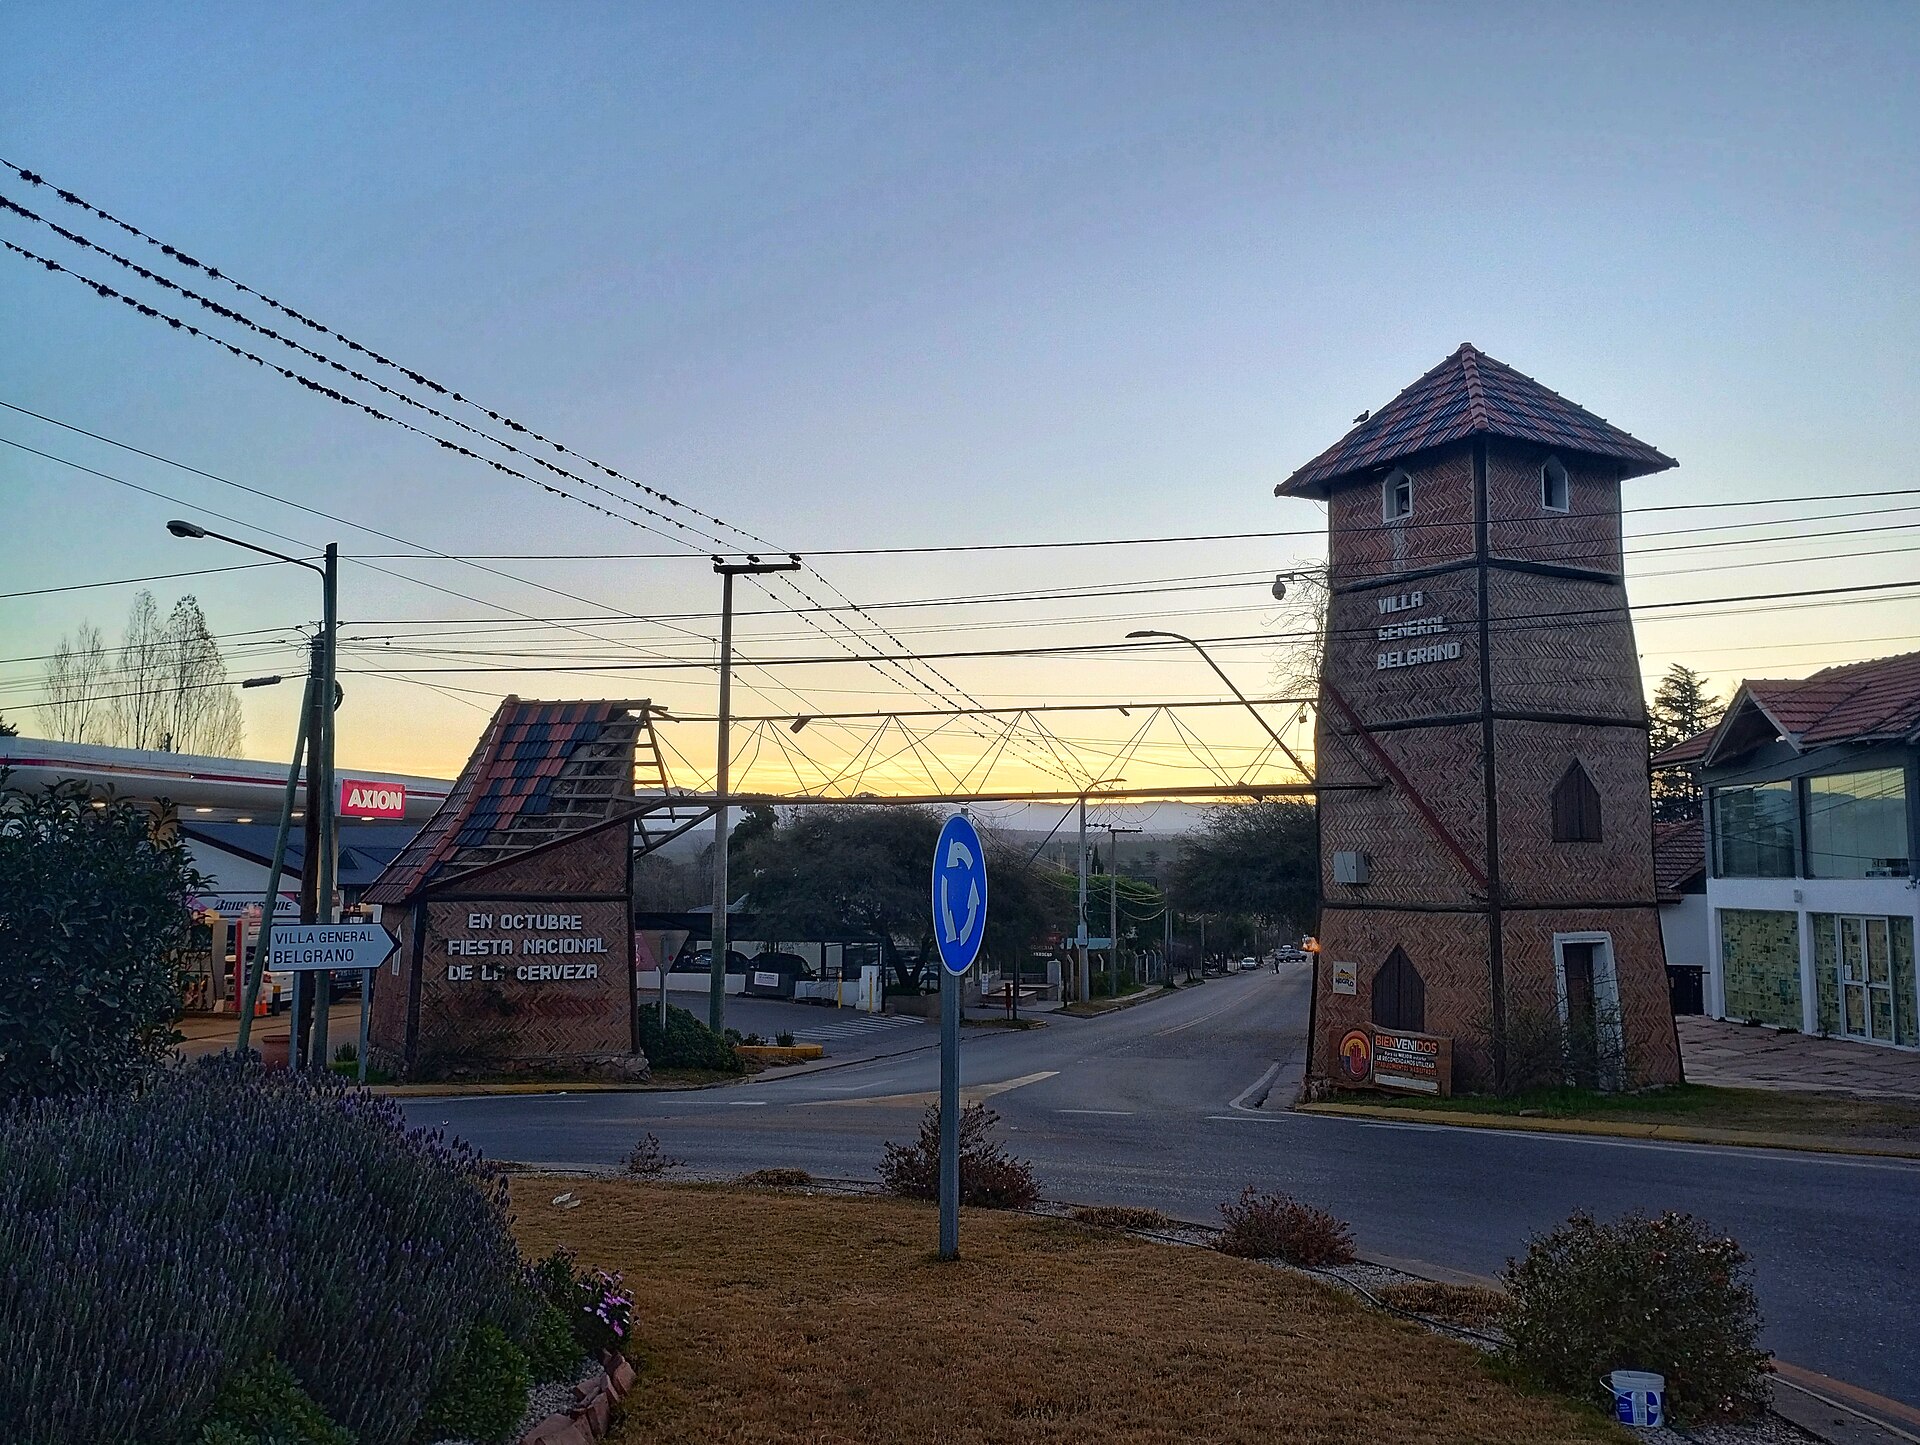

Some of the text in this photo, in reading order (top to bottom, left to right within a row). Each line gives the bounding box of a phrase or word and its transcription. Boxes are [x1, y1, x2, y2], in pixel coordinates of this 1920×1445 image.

[1378, 591, 1424, 615] VILLA
[1377, 642, 1461, 670] BELGRANO
[348, 788, 402, 810] AXION
[214, 899, 292, 911] BRIDESNE
[468, 913, 582, 930] EN OCTUBRE
[274, 931, 374, 945] VILLA GENERAL
[448, 938, 608, 956] FIESTA NACIONAL
[273, 948, 354, 964] BELGRANO
[448, 965, 473, 981] DE
[516, 964, 598, 980] CERVEZA
[1375, 1035, 1438, 1054] BIENVENIDOS
